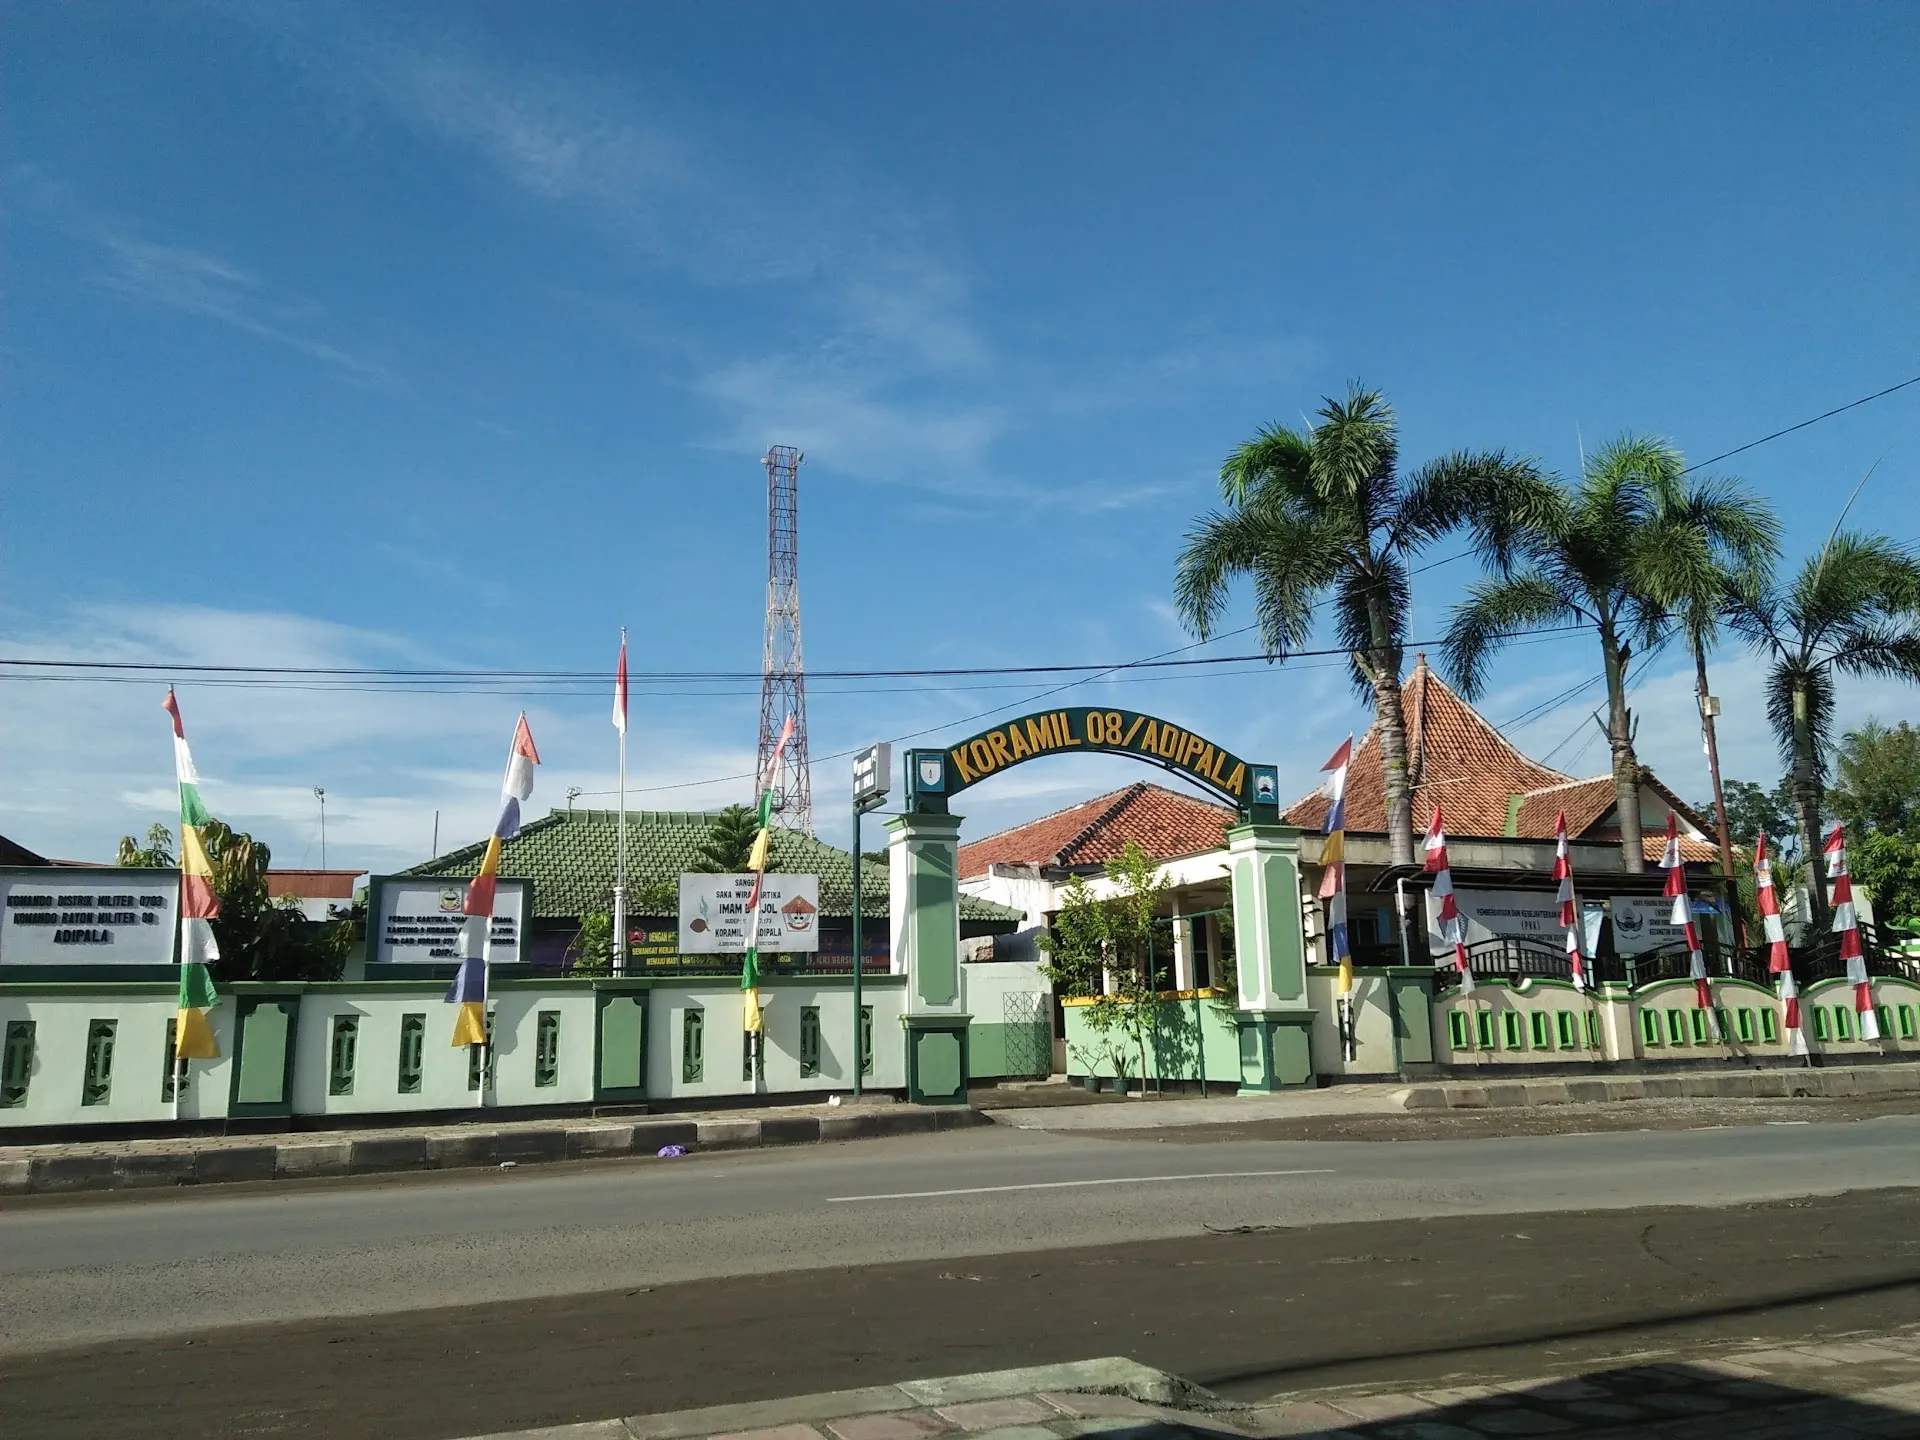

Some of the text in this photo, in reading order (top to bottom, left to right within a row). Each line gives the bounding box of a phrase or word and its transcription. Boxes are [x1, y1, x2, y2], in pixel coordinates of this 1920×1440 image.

[951, 711, 1246, 796] KORAMIL 08/ADIPALA
[716, 891, 732, 899] SAKA
[759, 891, 781, 899] ARTIKA
[6, 895, 53, 907] KOMANDO
[57, 895, 93, 907] DISTRIK
[97, 896, 134, 907] MILITER
[719, 904, 777, 914] IMAM BJOL
[13, 912, 58, 924] KOMANDO
[61, 912, 94, 924] RAYON
[97, 912, 136, 924] MILITER
[388, 915, 413, 923] PERSIT
[387, 926, 418, 934] RANTING
[715, 928, 782, 937] KORAMIL DIPALA
[53, 929, 109, 943] ADIPALA
[649, 932, 668, 942] DENGAN
[632, 947, 658, 955] SEMANGAT
